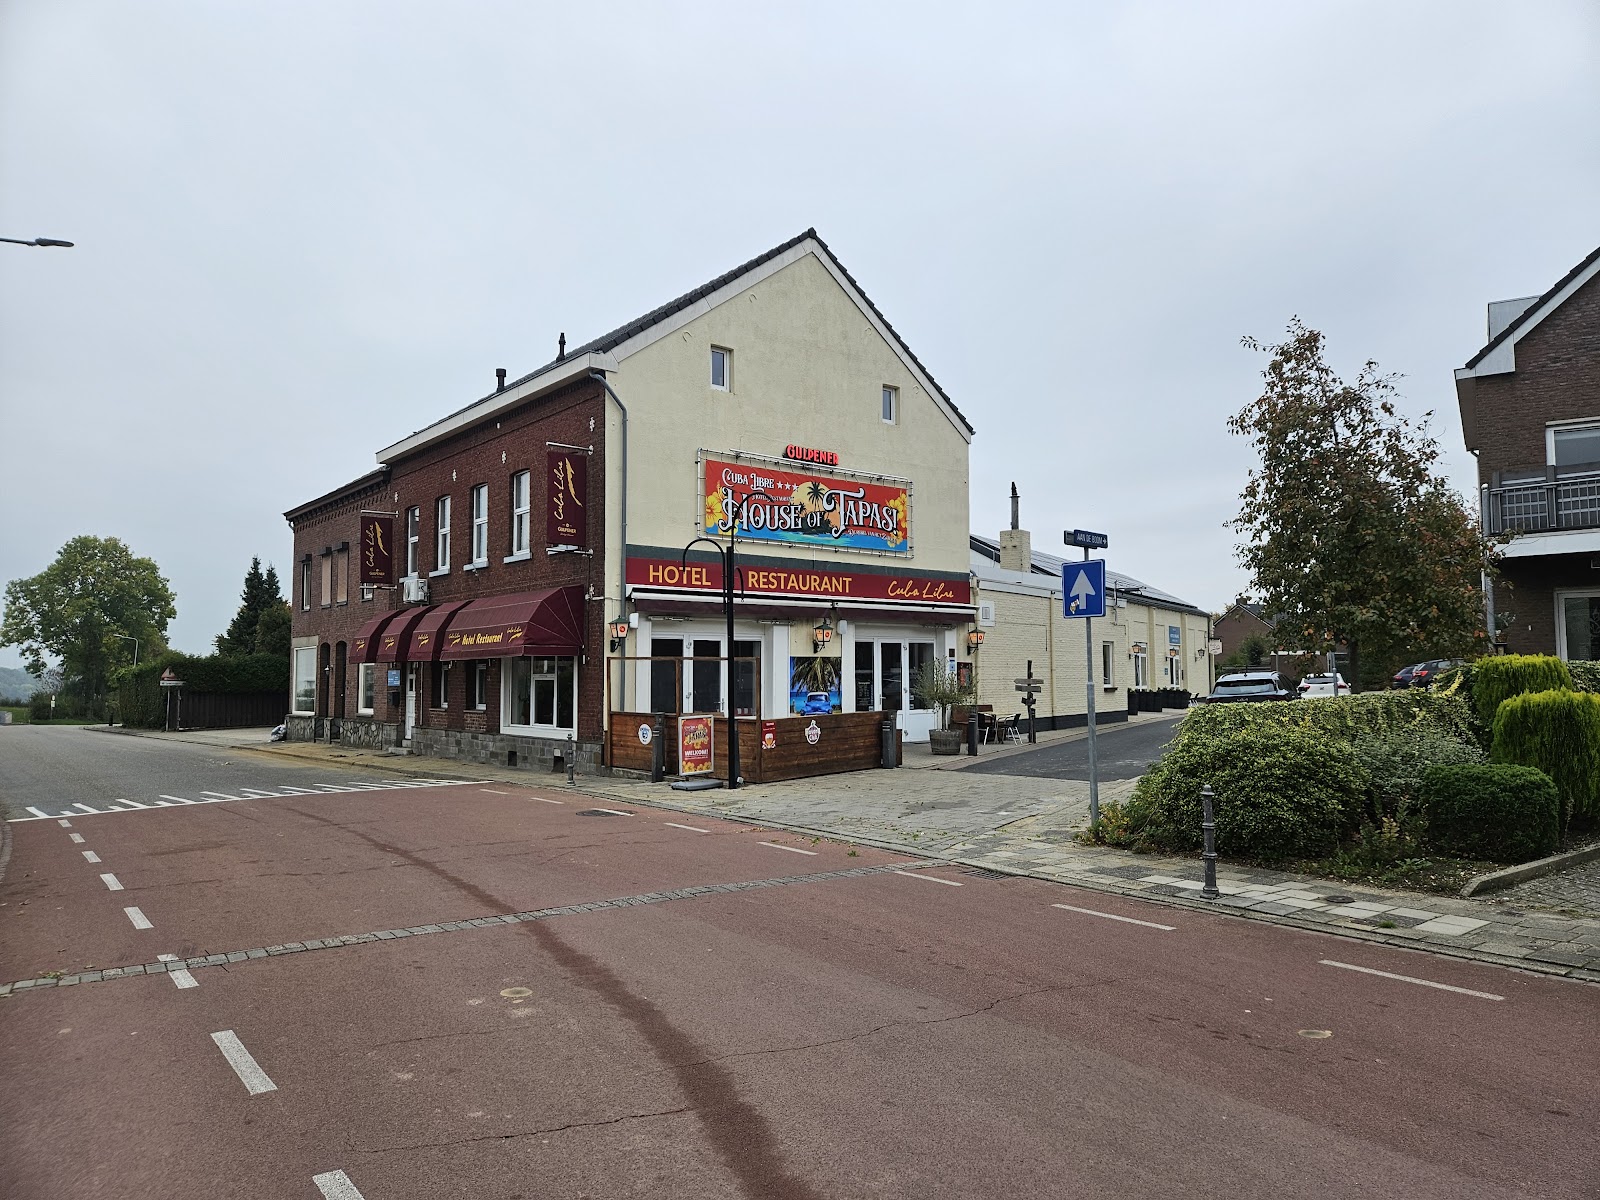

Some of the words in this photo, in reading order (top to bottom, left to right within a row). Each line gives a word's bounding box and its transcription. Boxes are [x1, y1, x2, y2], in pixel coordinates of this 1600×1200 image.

[787, 444, 839, 465] GULPENER
[722, 468, 749, 487] CUBA
[750, 473, 775, 492] LIBRE
[718, 487, 803, 531] HOUSE
[807, 511, 823, 527] OF
[823, 488, 898, 538] TAPAS!
[1076, 533, 1086, 542] AAN
[1086, 534, 1092, 543] DE
[649, 564, 712, 586] HOTEL
[748, 570, 852, 593] RESTAURANT
[888, 580, 920, 598] Cuba
[922, 582, 954, 600] Libre
[462, 634, 476, 645] Hotel
[476, 632, 504, 644] Restaurant
